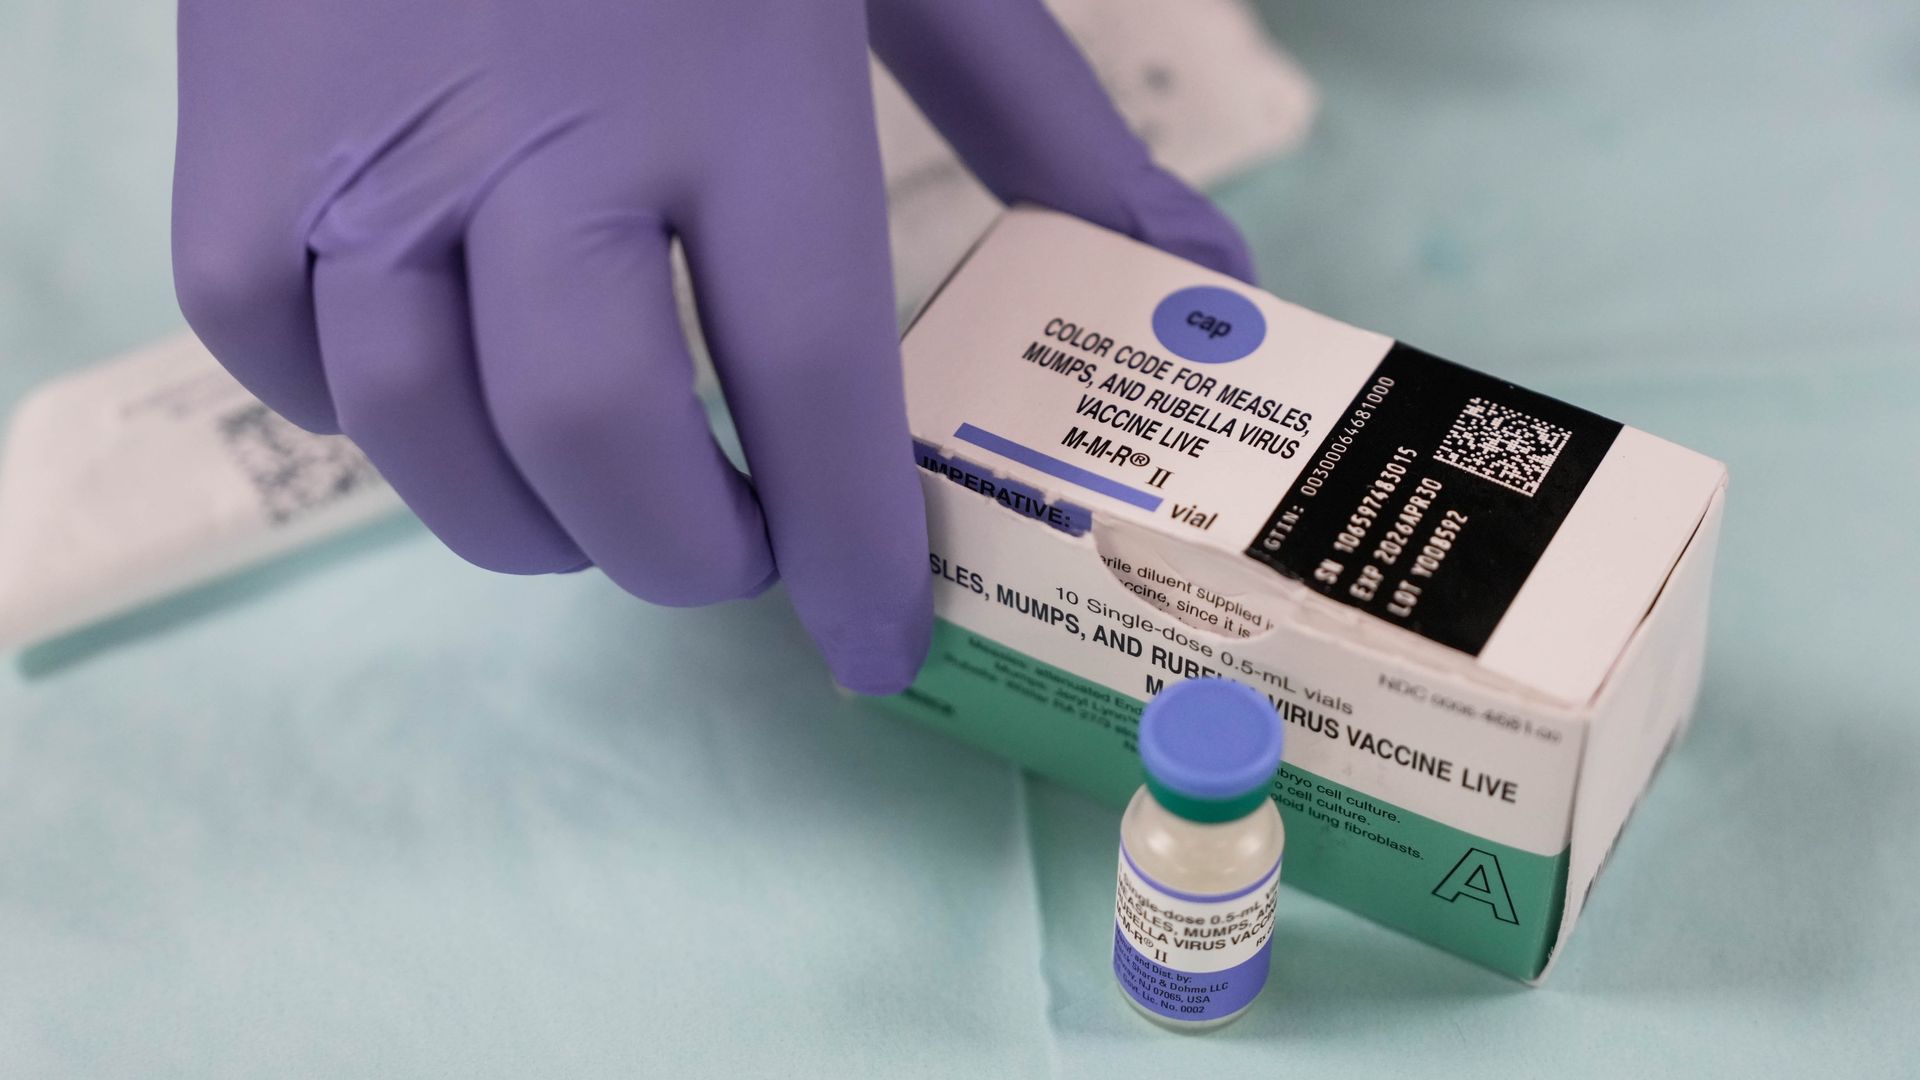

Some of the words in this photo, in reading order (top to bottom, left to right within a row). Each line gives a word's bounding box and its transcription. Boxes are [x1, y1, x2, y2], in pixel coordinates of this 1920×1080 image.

[1186, 310, 1232, 339] cap
[1022, 341, 1097, 389] MUMPS,
[1098, 373, 1146, 402] AND
[1144, 389, 1237, 438] RUBELLA
[1238, 422, 1300, 460] VIRUS
[1044, 317, 1115, 358] COLOR
[1114, 345, 1174, 381] CODE
[1171, 367, 1217, 398] FOR
[1216, 384, 1312, 438] MEASLES,
[1075, 394, 1163, 441] VACCINE
[1158, 427, 1210, 459] LIVE
[1061, 426, 1151, 468] M-M-R®
[1145, 466, 1175, 490] II
[1263, 504, 1305, 551] GTIN:
[1300, 376, 1396, 497] 00300064681000
[922, 456, 1071, 528] IMPERATIVE:
[1170, 503, 1218, 531] vial
[1349, 564, 1385, 602] EXP
[1373, 477, 1443, 566] 2026APR30
[1137, 566, 1193, 594] diluent
[1196, 586, 1262, 627] supplied
[1314, 558, 1344, 585] SN
[1386, 579, 1422, 618] LOT
[1118, 578, 1171, 607] ccine,
[1176, 599, 1219, 626] since
[1224, 616, 1235, 632] it
[1238, 625, 1251, 639] is
[1055, 586, 1080, 606] 10
[1086, 597, 1214, 658] Single-dose
[1220, 650, 1297, 694] 0.5-mL
[1302, 685, 1355, 716] vials
[996, 583, 1086, 641] MUMPS,
[1092, 624, 1143, 658] AND
[1268, 694, 1340, 740] VIRUS
[1346, 724, 1454, 783] VACCINE
[1461, 767, 1520, 804] LIVE
[1287, 786, 1313, 802] cell
[1316, 798, 1371, 826] culture.
[1316, 784, 1342, 801] cell
[1346, 796, 1401, 824] culture.
[1308, 806, 1340, 829] lung
[1344, 819, 1424, 861] fibroblasts.
[1431, 847, 1520, 925] A
[1134, 954, 1150, 970] and
[1152, 965, 1174, 980] Dist.
[1176, 973, 1192, 984] by:
[1154, 948, 1168, 964] II
[1174, 936, 1226, 951] VIRUS
[1131, 960, 1157, 984] Sharp
[1158, 979, 1167, 988] &
[1169, 982, 1207, 994] Dohme
[1210, 981, 1229, 993] LLC
[1138, 978, 1151, 991] NJ
[1153, 986, 1184, 1003] 07065,
[1187, 995, 1210, 1004] USA
[1142, 991, 1158, 1005] Lic.
[1160, 1000, 1178, 1012] No.
[1180, 1005, 1205, 1014] 0002
